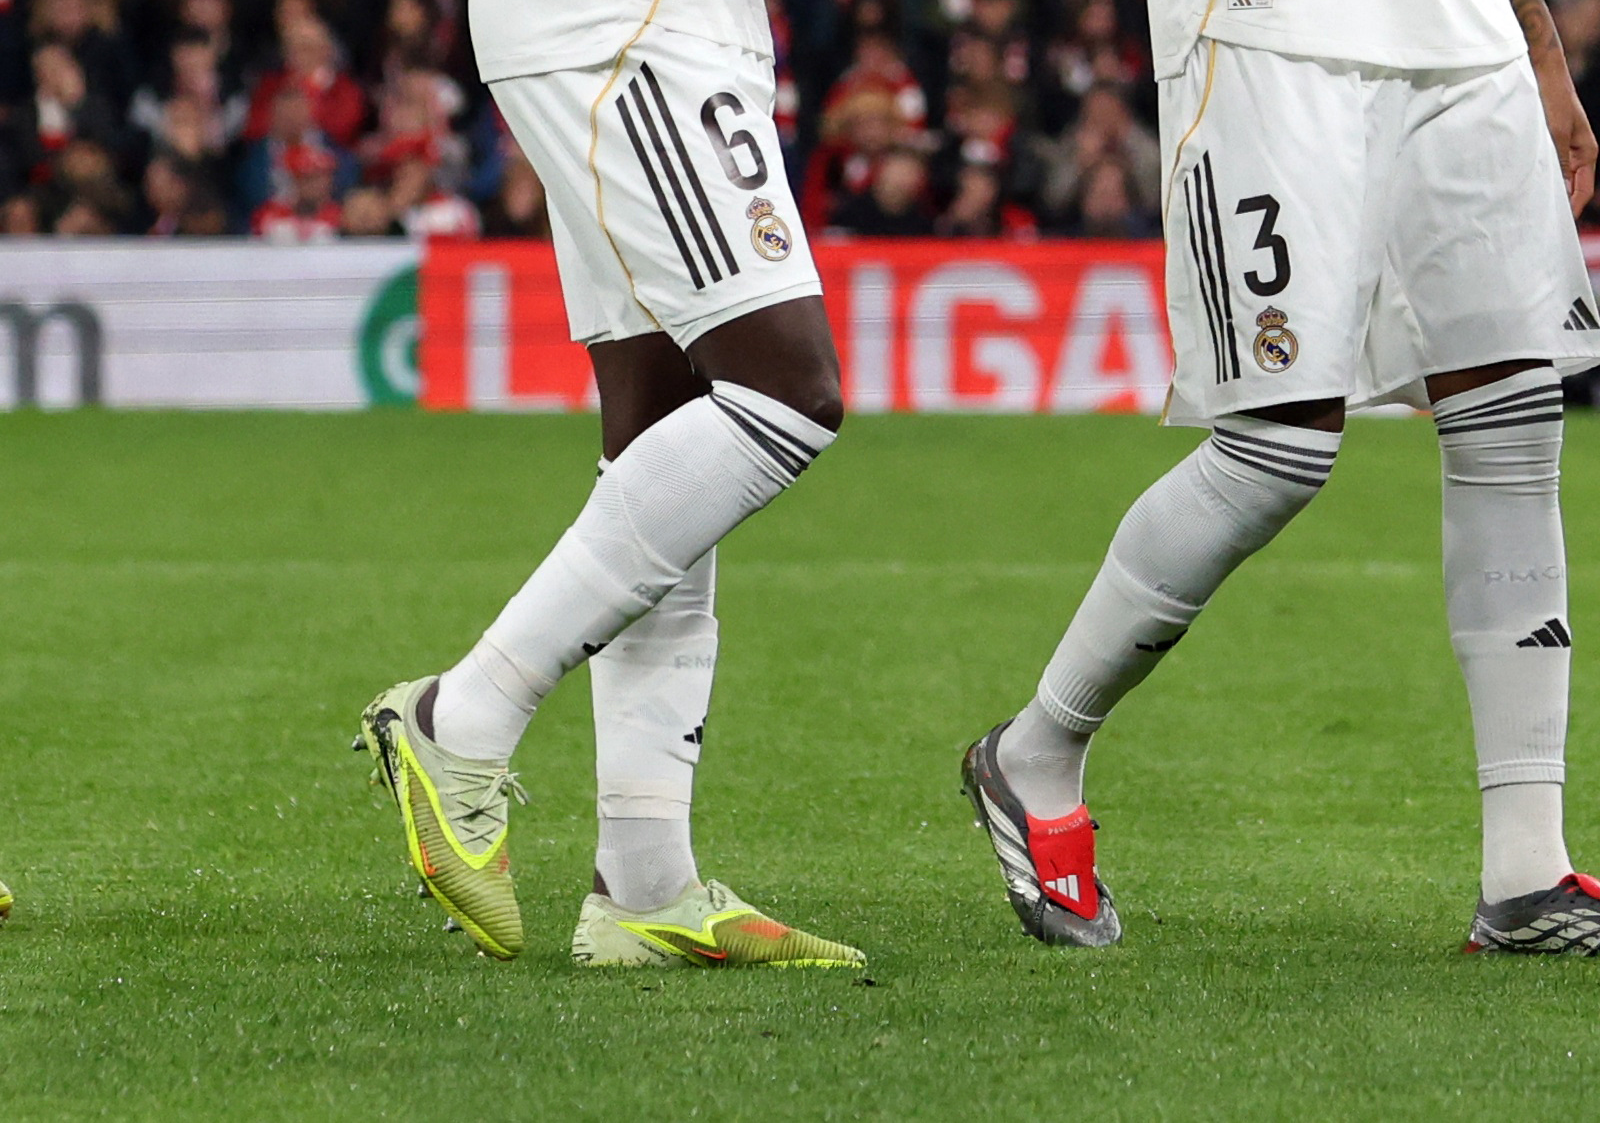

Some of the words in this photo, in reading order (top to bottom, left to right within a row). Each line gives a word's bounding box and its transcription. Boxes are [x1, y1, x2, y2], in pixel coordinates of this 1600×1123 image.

[699, 91, 769, 191] 6
[1234, 193, 1292, 297] 3
[465, 261, 1172, 415] LIGA
